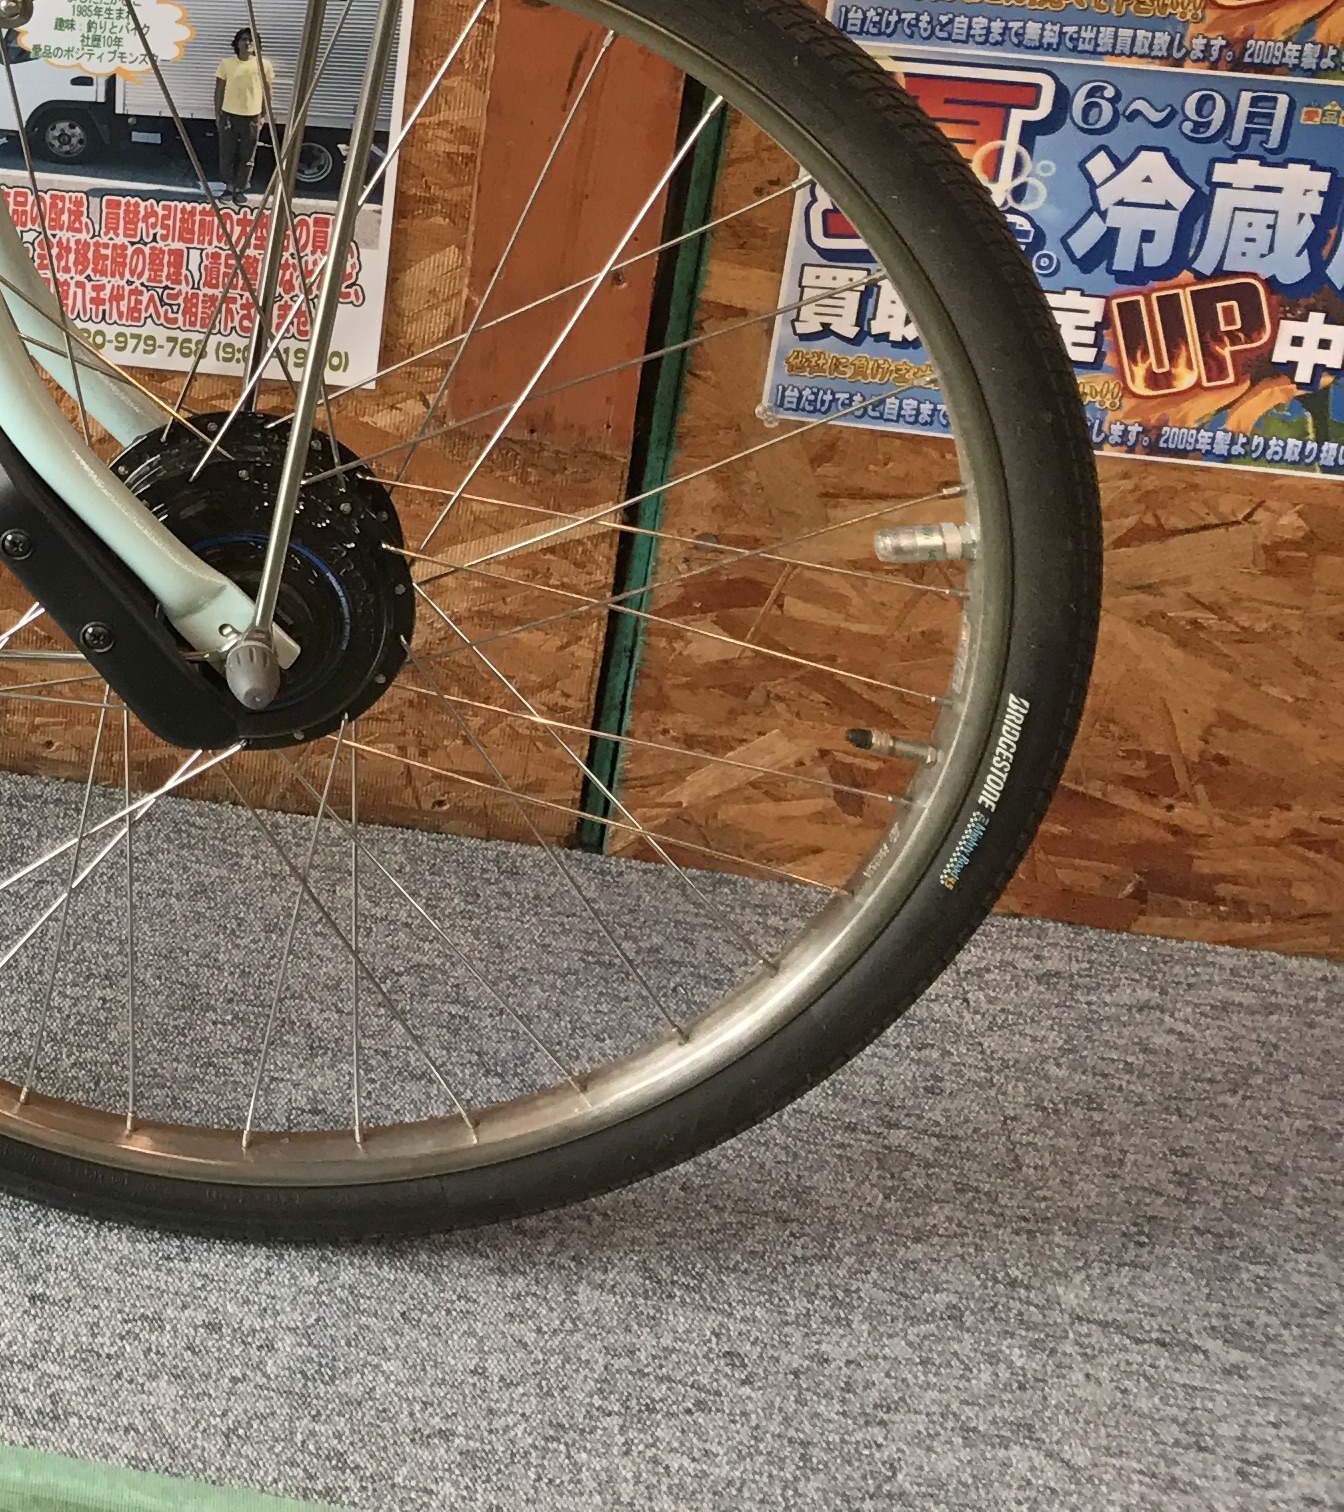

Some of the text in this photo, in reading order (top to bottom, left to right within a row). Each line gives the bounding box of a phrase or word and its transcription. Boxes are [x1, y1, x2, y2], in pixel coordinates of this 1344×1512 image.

[79, 33, 124, 49] 社歴10年
[1062, 150, 1344, 289] 冷蔵
[977, 692, 1030, 812] BRIDGESTONE
